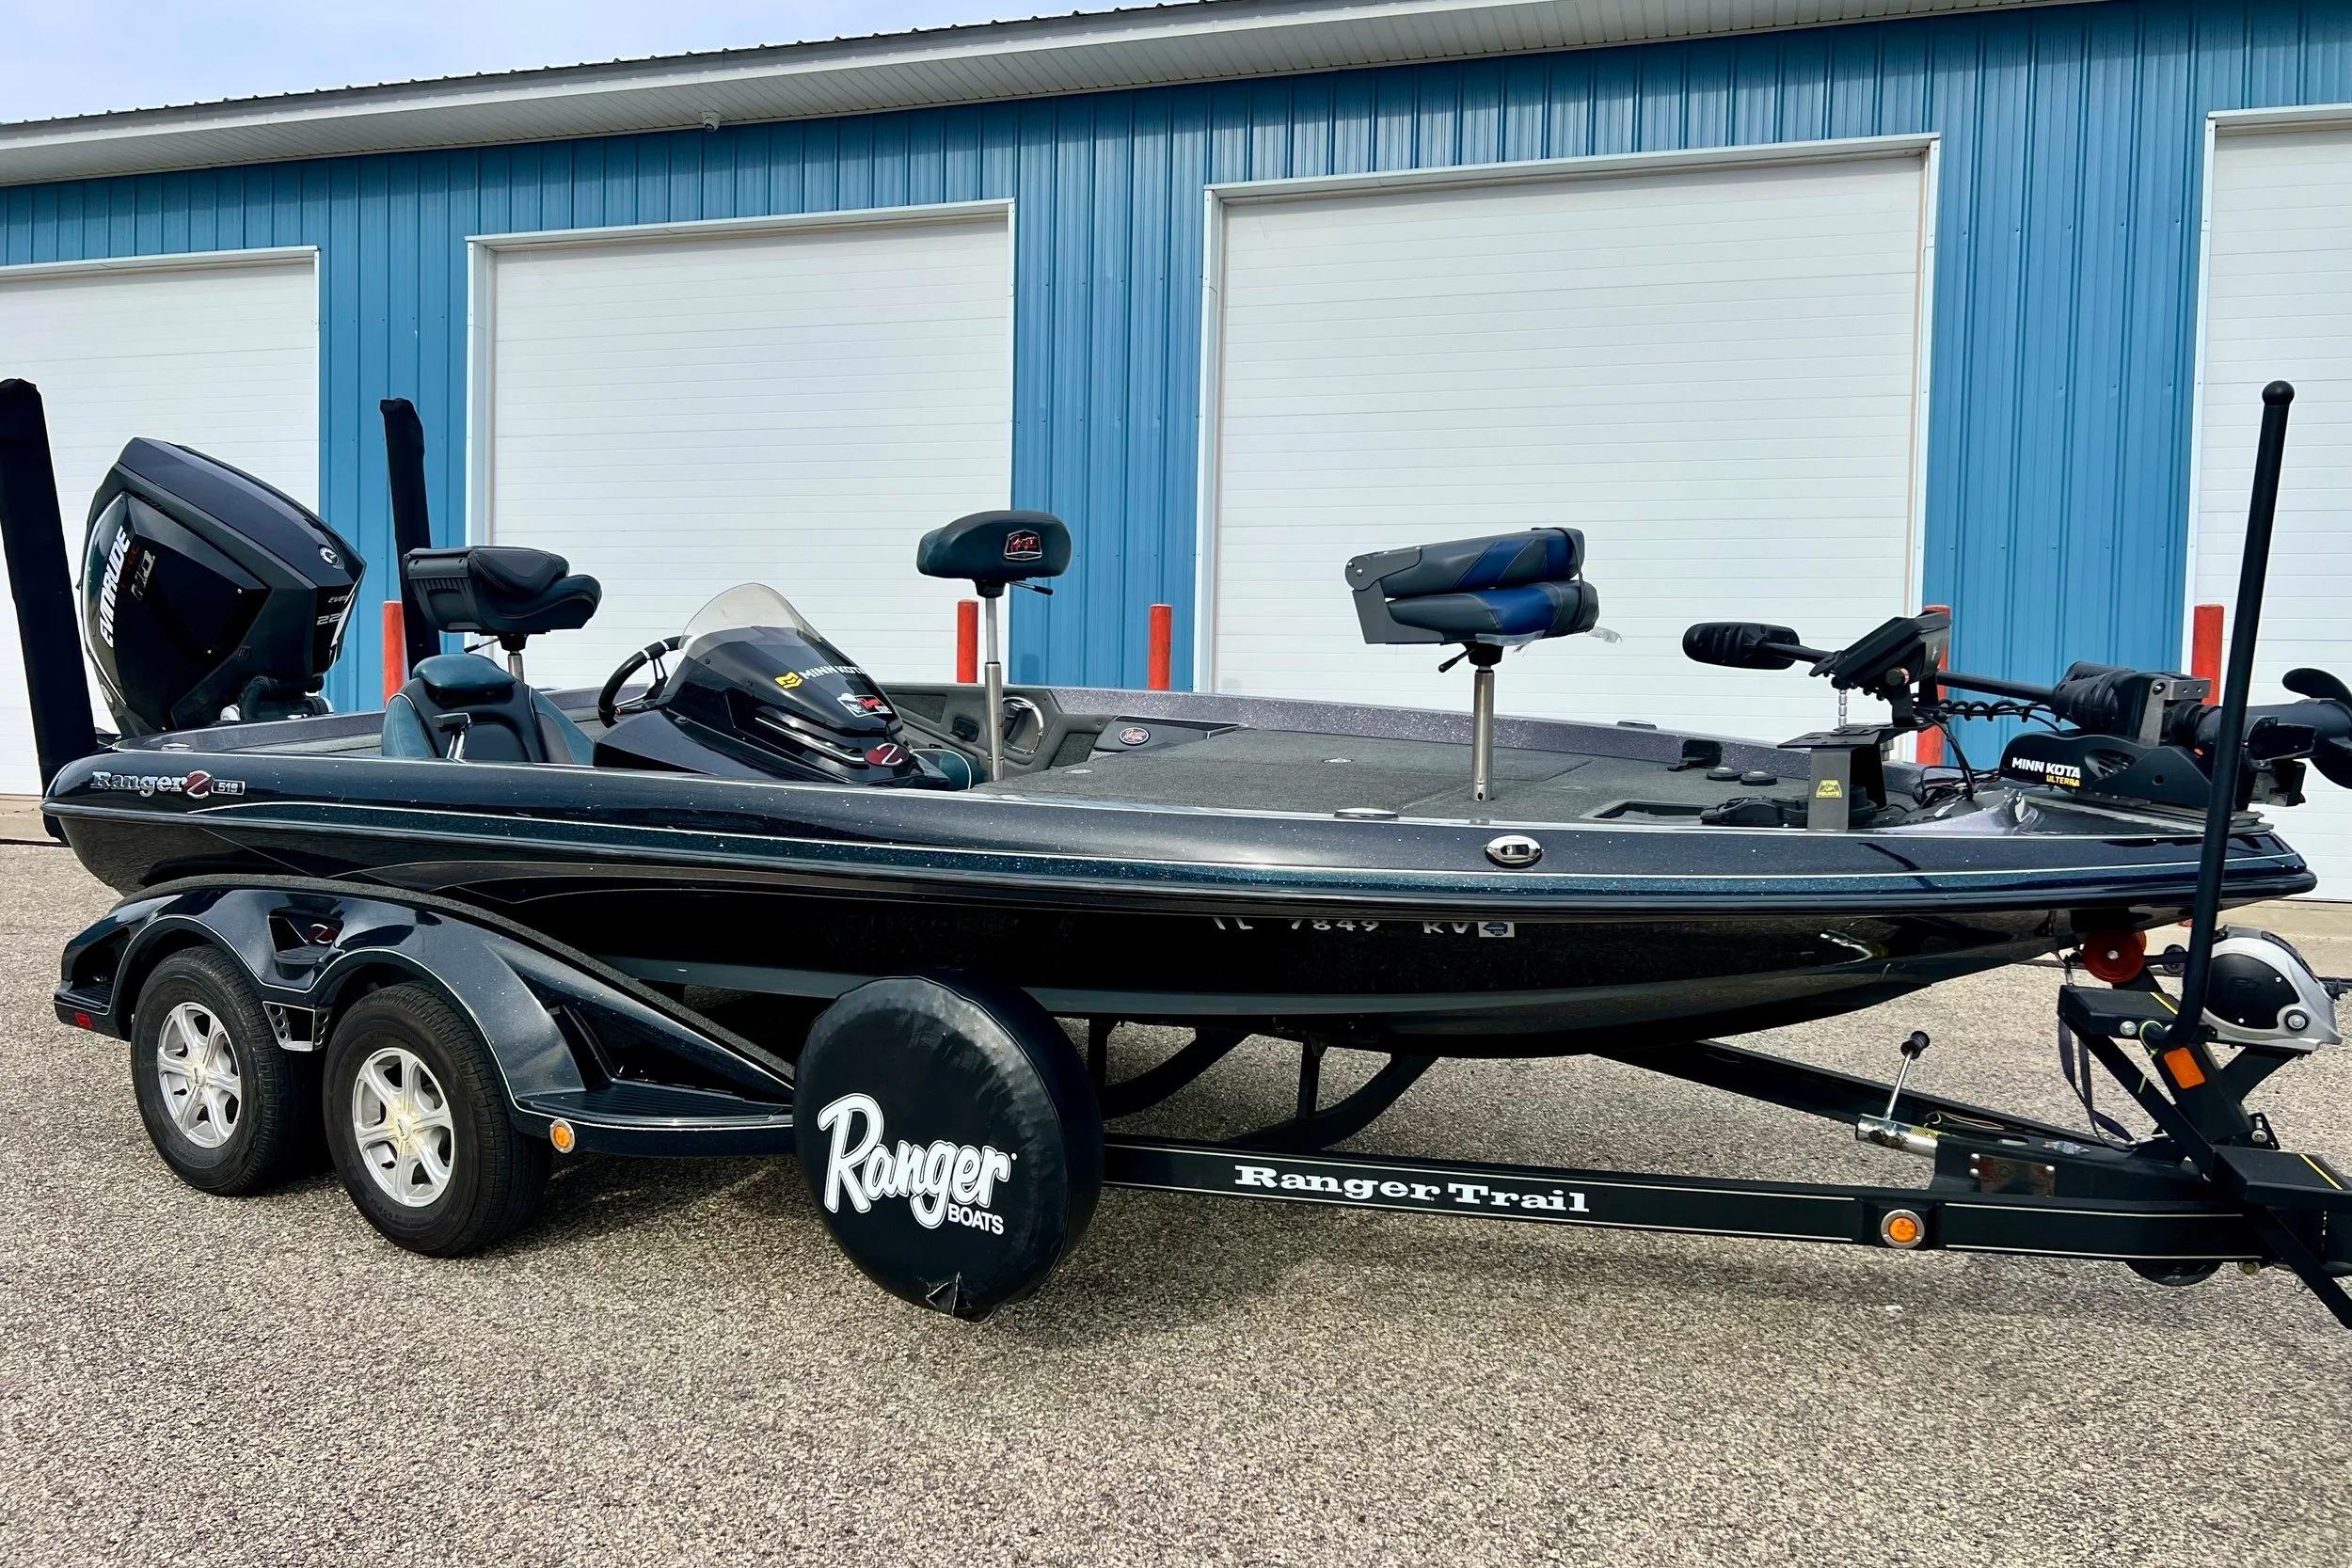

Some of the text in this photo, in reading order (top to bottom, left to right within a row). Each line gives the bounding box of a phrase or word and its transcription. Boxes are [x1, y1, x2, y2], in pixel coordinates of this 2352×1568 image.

[100, 525, 131, 648] EVINRUDE
[316, 612, 343, 626] 22
[798, 665, 838, 680] MINN
[2011, 756, 2081, 779] MINN KOTA
[90, 770, 188, 798] Ranger
[217, 782, 238, 793] 519
[2045, 774, 2081, 787] ULTERRA
[1287, 917, 1379, 931] 7849
[818, 1092, 1011, 1229] Ranger
[1234, 1164, 1590, 1213] Ranger Trail
[947, 1202, 1005, 1235] BOATS
